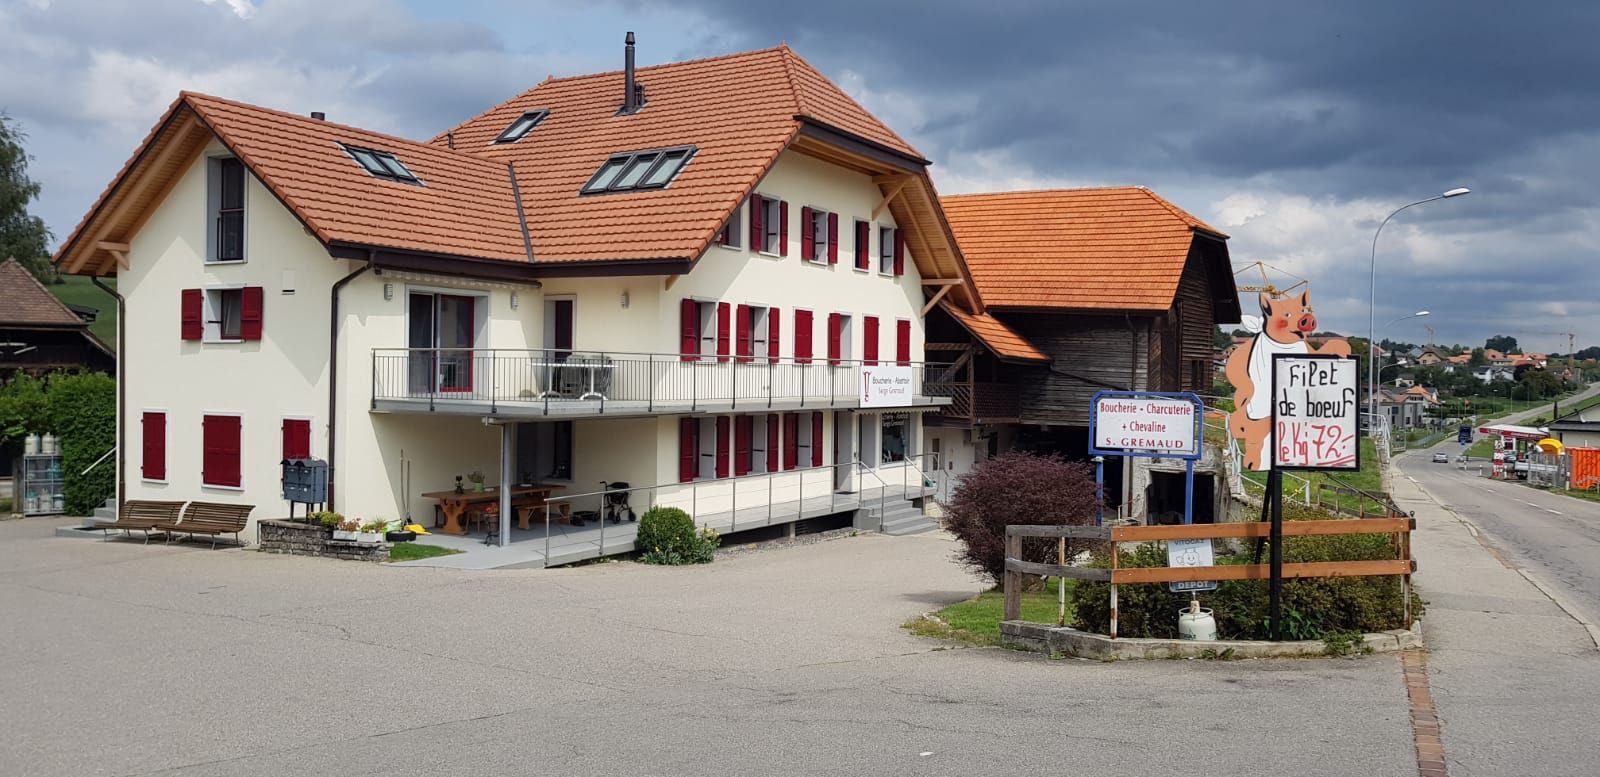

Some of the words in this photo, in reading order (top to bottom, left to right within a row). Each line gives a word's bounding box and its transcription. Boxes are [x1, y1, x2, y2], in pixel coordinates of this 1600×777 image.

[872, 376, 892, 385] Boucherie
[1290, 361, 1338, 387] Filet
[1101, 402, 1137, 414] Boucherie
[1146, 403, 1191, 416] Charcuterie
[1279, 388, 1296, 417] de
[1306, 388, 1355, 418] boeuf
[1122, 423, 1127, 431] +
[1129, 421, 1166, 432] Chevaline
[1105, 437, 1116, 446] S.
[1121, 438, 1184, 448] GREMAUD
[1279, 421, 1290, 462] le
